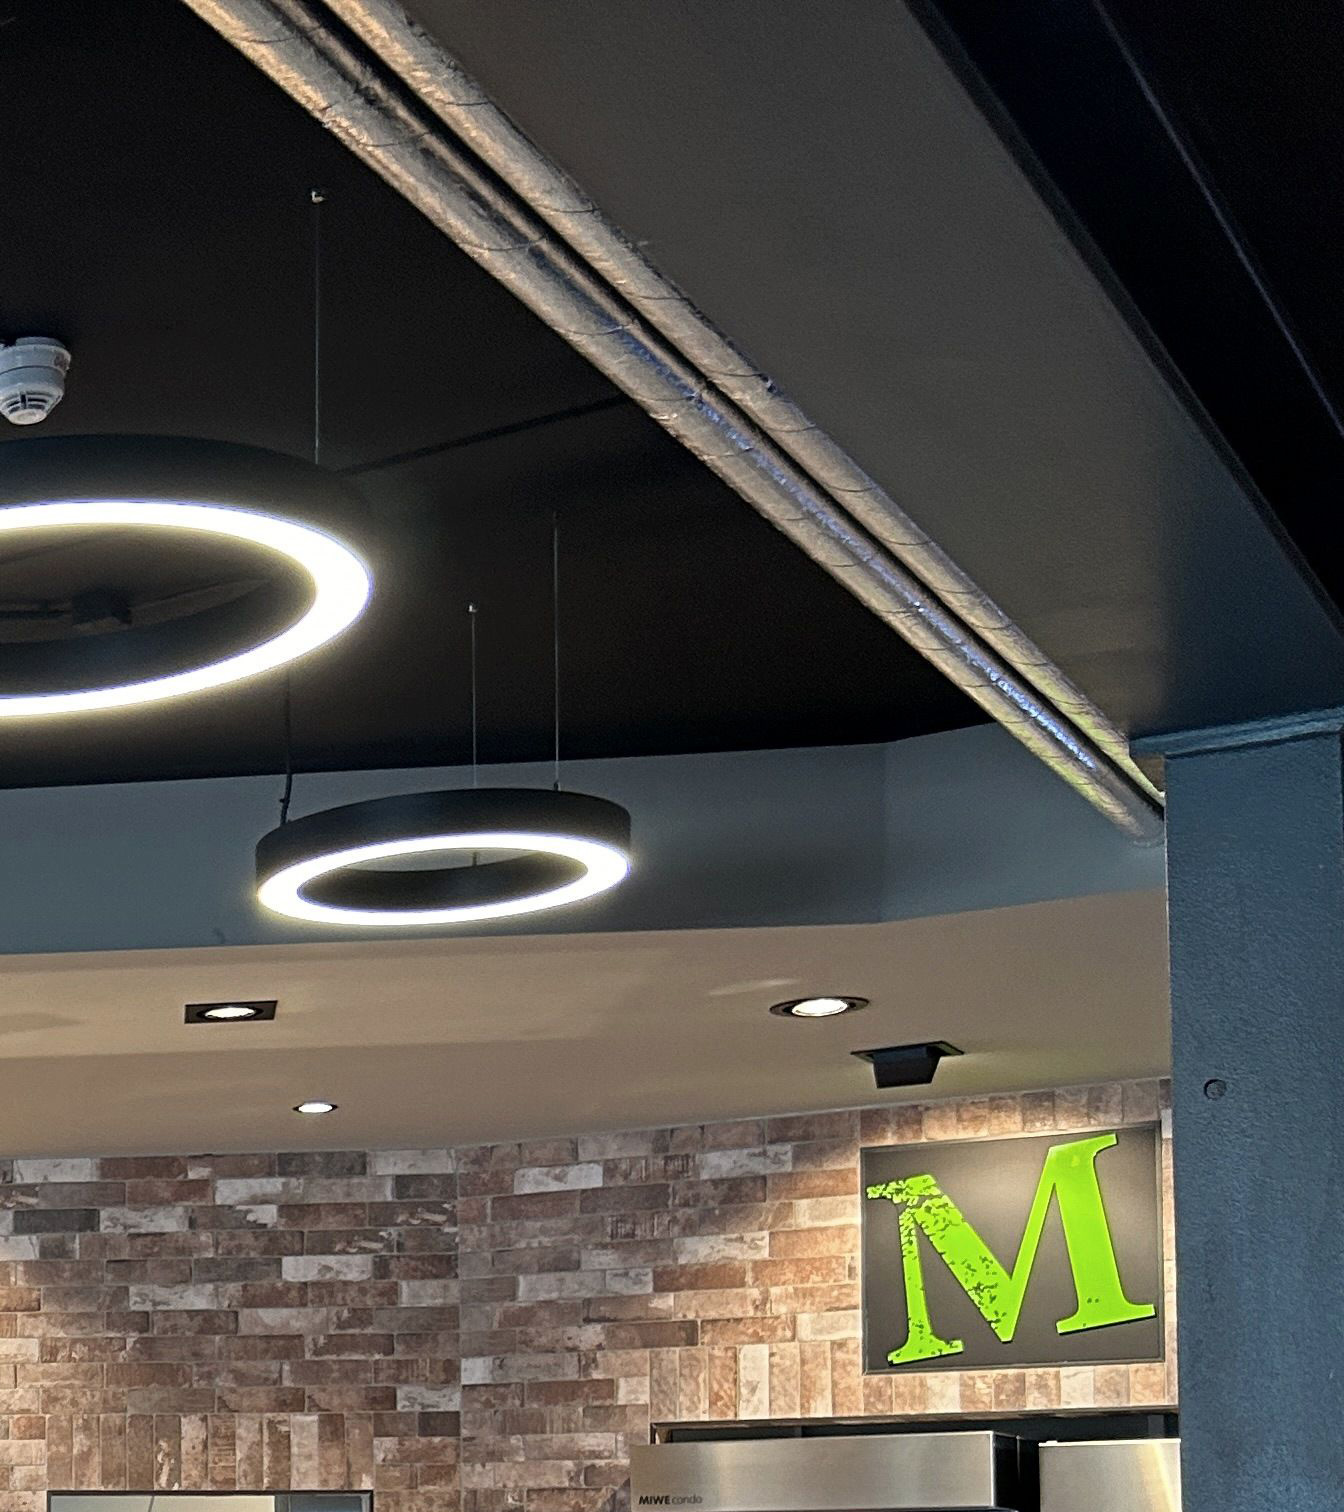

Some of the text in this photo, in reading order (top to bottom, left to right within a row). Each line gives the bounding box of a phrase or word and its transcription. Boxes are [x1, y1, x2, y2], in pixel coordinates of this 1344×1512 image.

[867, 1134, 1156, 1365] M
[639, 1494, 703, 1505] MIWE condo
